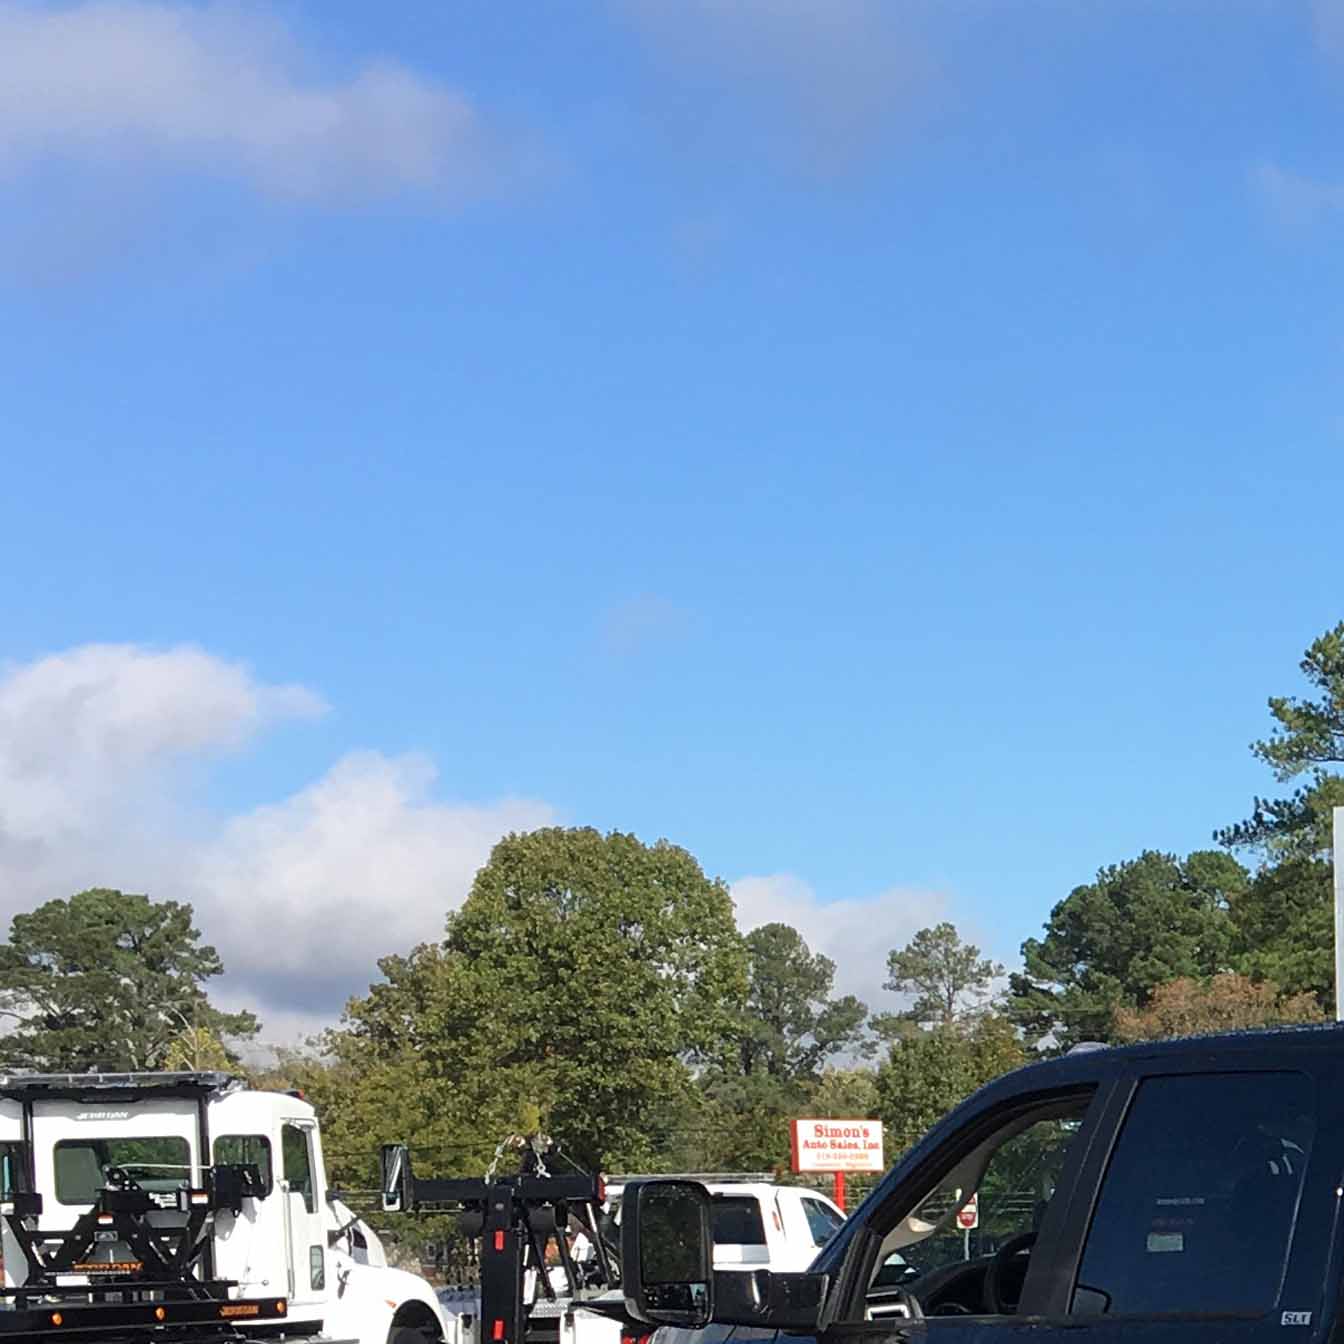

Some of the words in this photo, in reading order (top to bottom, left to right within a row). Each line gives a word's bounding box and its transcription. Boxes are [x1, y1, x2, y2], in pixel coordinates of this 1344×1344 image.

[814, 1124, 870, 1138] Simon's
[803, 1140, 829, 1150] Auto
[1281, 1311, 1313, 1326] SLT
